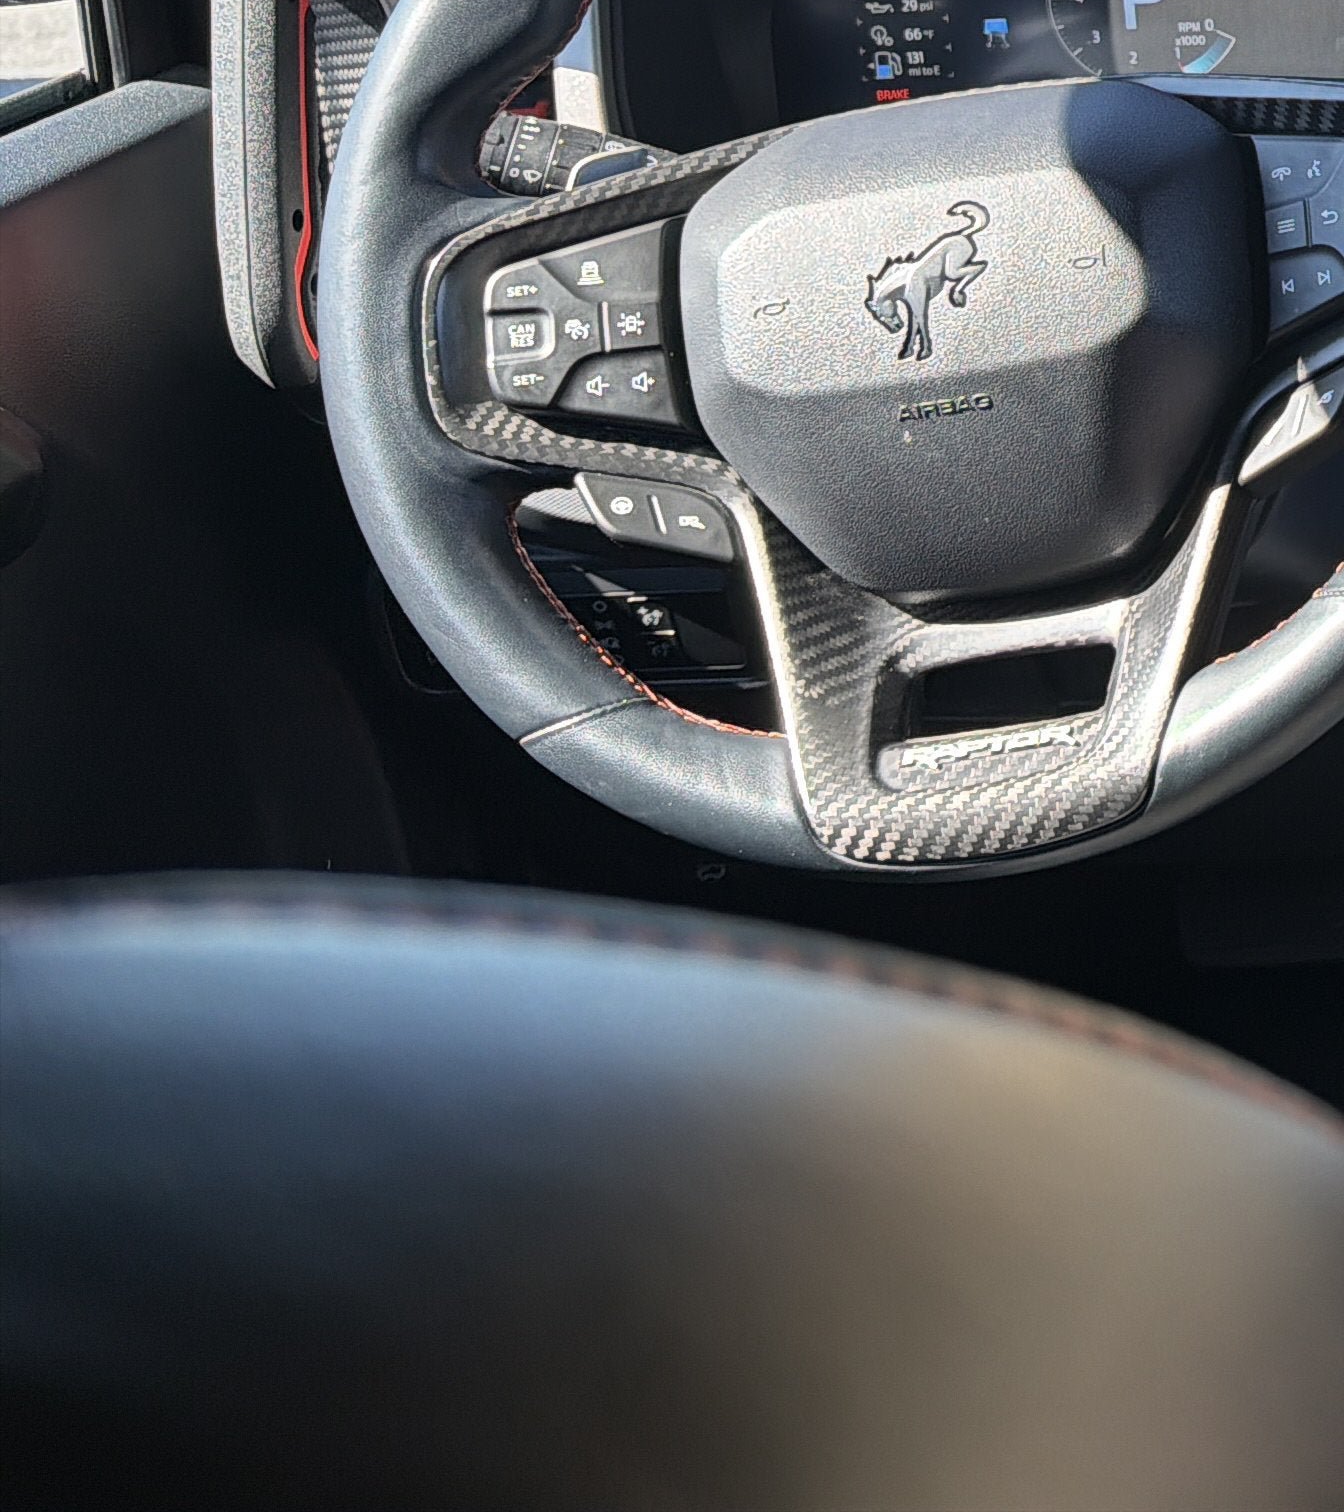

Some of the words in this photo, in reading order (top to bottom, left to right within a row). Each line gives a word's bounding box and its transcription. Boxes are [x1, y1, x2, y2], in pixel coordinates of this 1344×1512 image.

[1177, 21, 1201, 33] RPM
[1091, 29, 1101, 44] 3
[906, 51, 925, 65] 131
[1129, 50, 1139, 65] 2
[876, 88, 910, 101] BRAKE
[508, 323, 536, 335] CAN
[898, 392, 994, 423] AIRBAG
[900, 724, 1081, 770] RAPTOR
